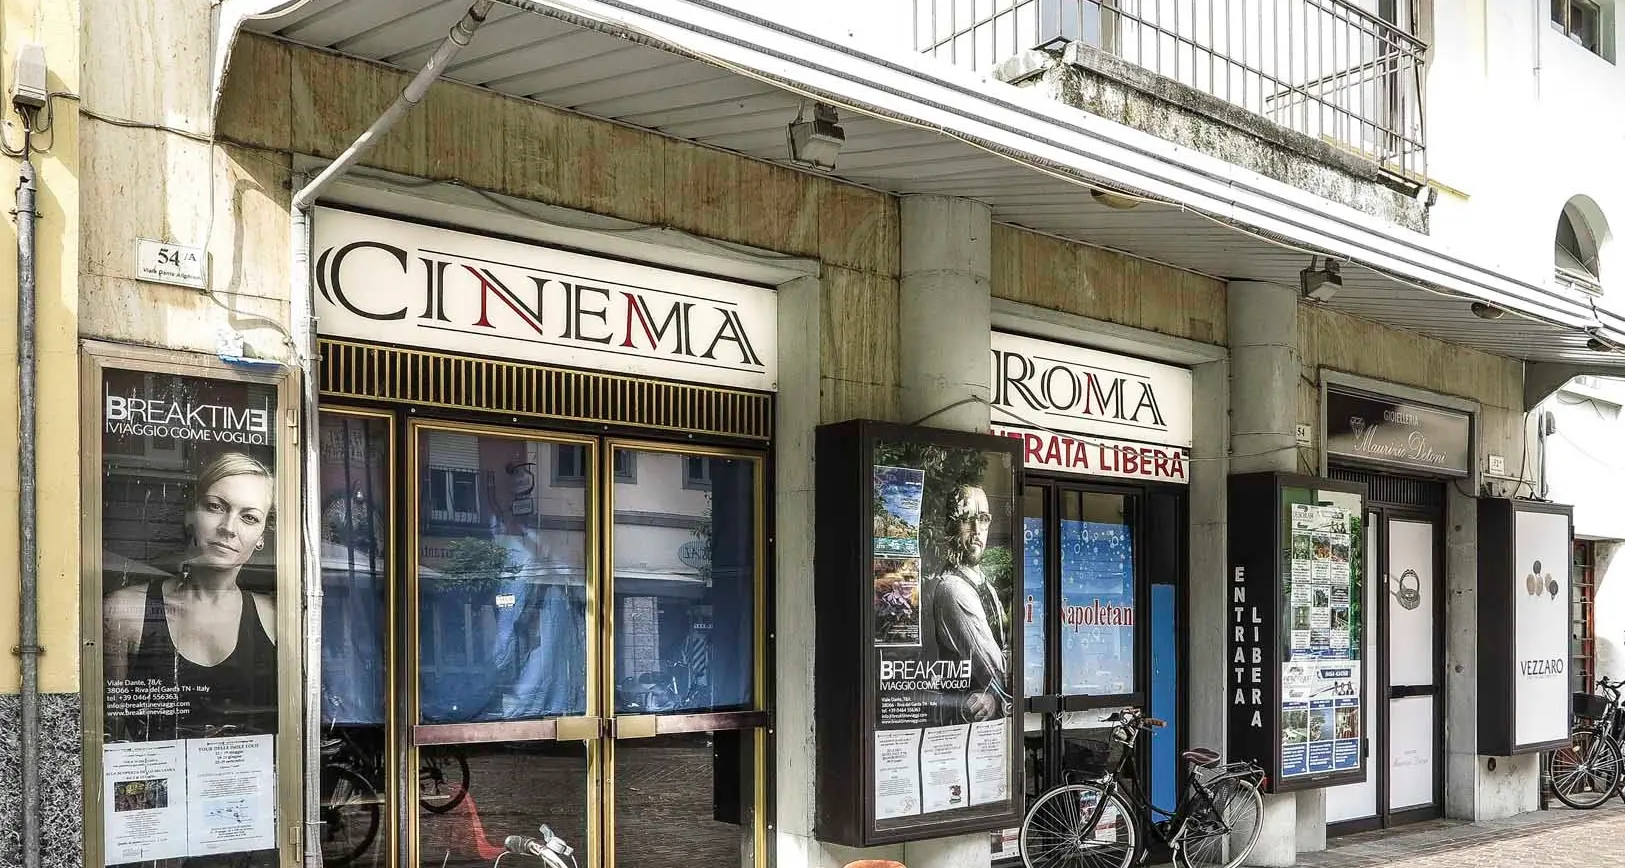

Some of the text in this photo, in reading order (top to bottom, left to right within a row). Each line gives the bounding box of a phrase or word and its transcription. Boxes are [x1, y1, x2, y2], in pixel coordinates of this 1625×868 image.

[316, 240, 766, 367] CINEMA
[991, 348, 1168, 427] ROMA
[109, 422, 266, 445] VIAGGIO COME VOGLIO.
[1383, 409, 1419, 426] GIOIELLERIA
[1354, 424, 1406, 458] Maurizio
[1099, 442, 1185, 479] LIBERA
[1233, 566, 1246, 705] ENTRATA
[1250, 606, 1262, 728] LIBERA
[1520, 658, 1564, 677] VEZZARO
[196, 685, 210, 693] Italy
[881, 680, 916, 691] VIAGGIO
[916, 680, 940, 690] COME
